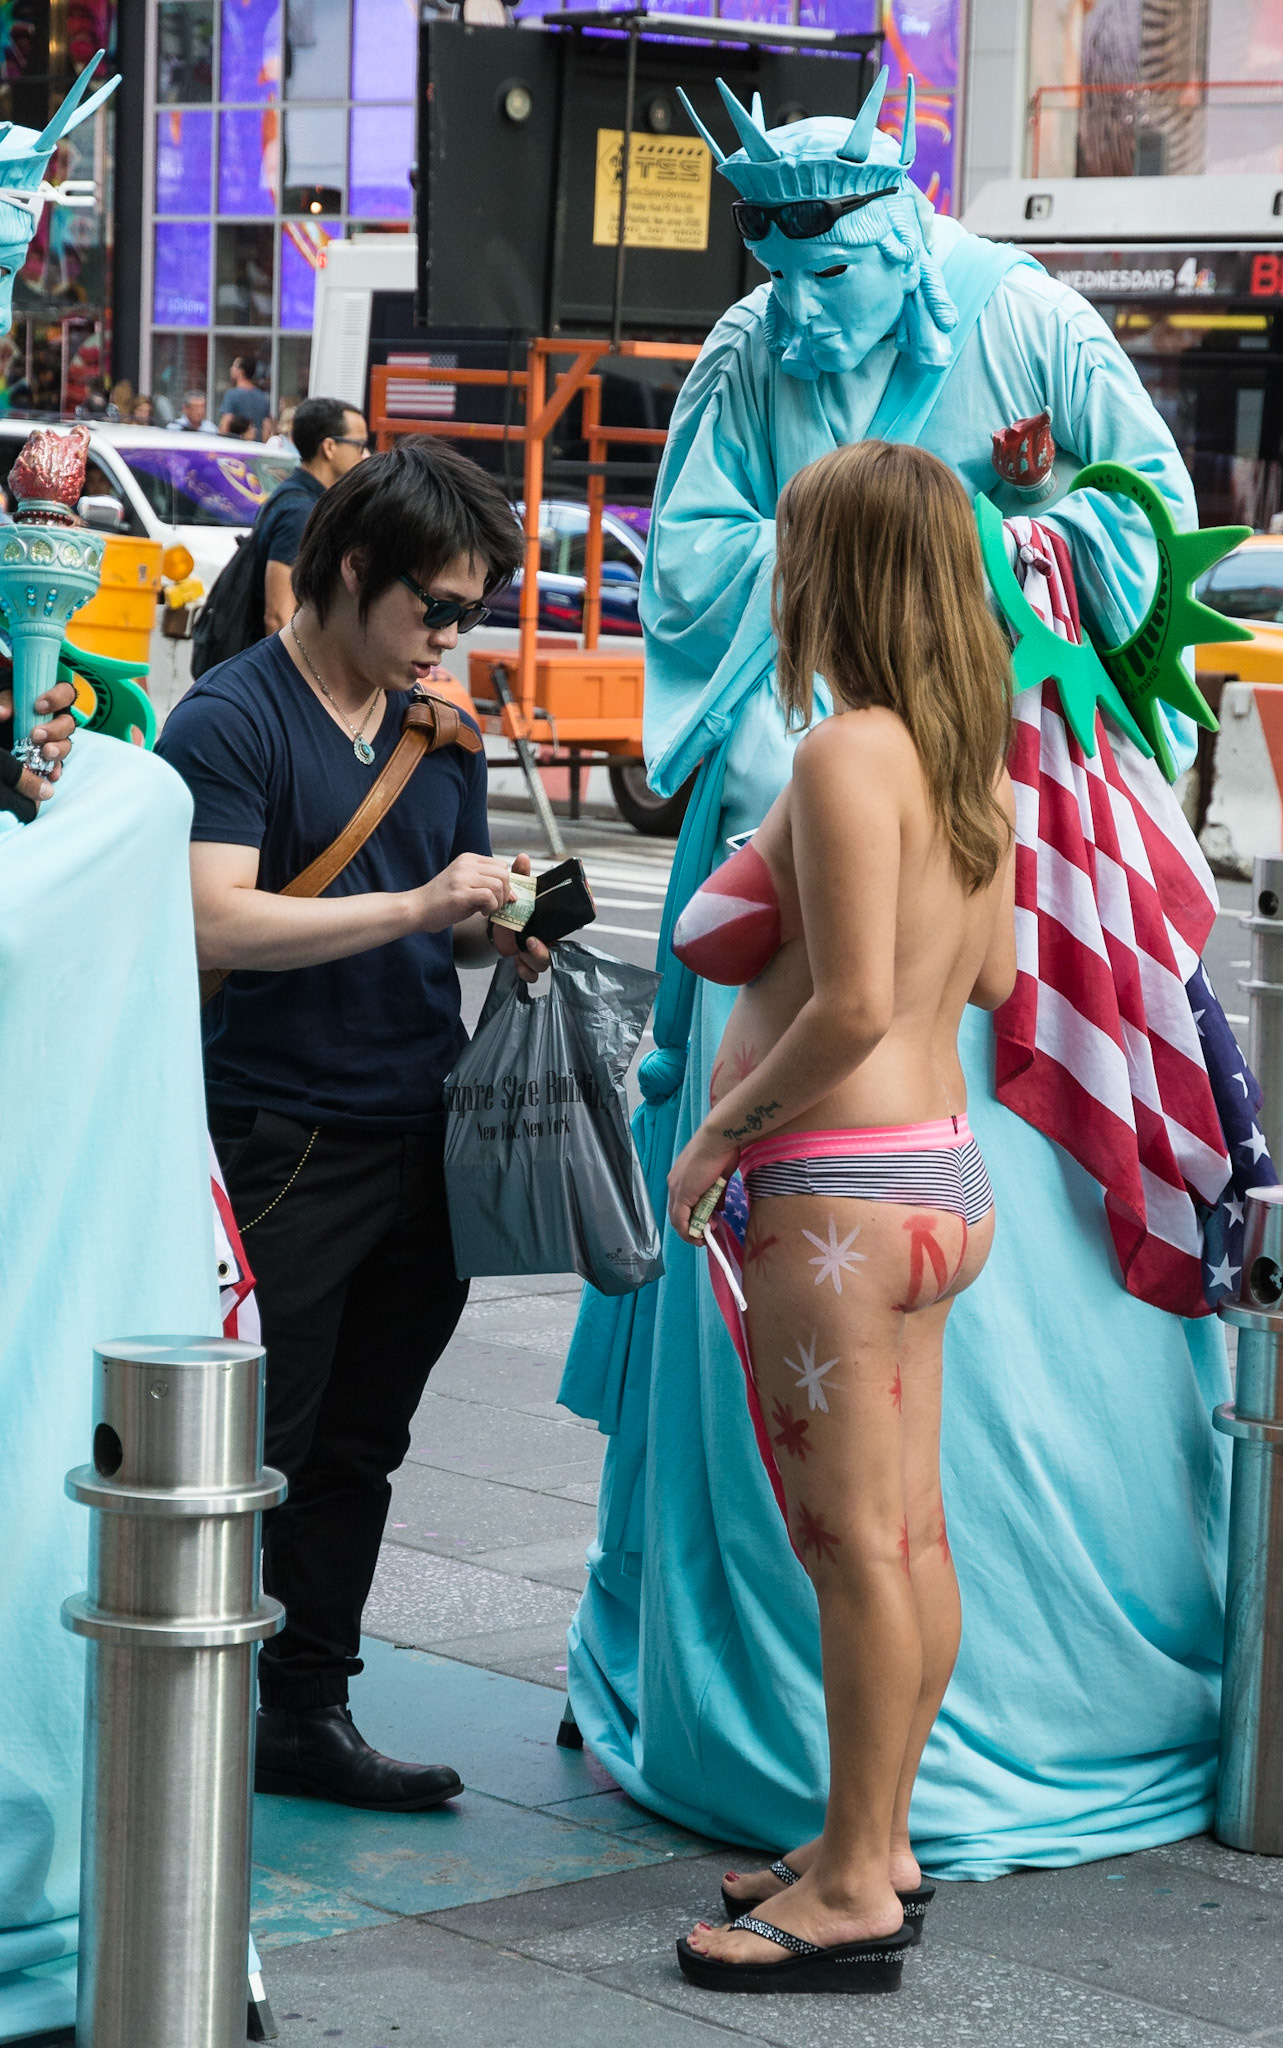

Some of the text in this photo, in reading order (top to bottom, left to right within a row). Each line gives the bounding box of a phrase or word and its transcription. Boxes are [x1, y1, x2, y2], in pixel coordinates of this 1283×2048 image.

[634, 156, 701, 182] TSS
[1056, 270, 1175, 292] WEDNESDAYS
[1176, 257, 1198, 288] 4
[1250, 254, 1283, 297] B
[445, 1078, 494, 1118] mpire
[501, 1075, 539, 1110] Stae
[476, 1121, 497, 1142] New
[522, 1117, 545, 1138] New
[547, 1113, 571, 1136] York
